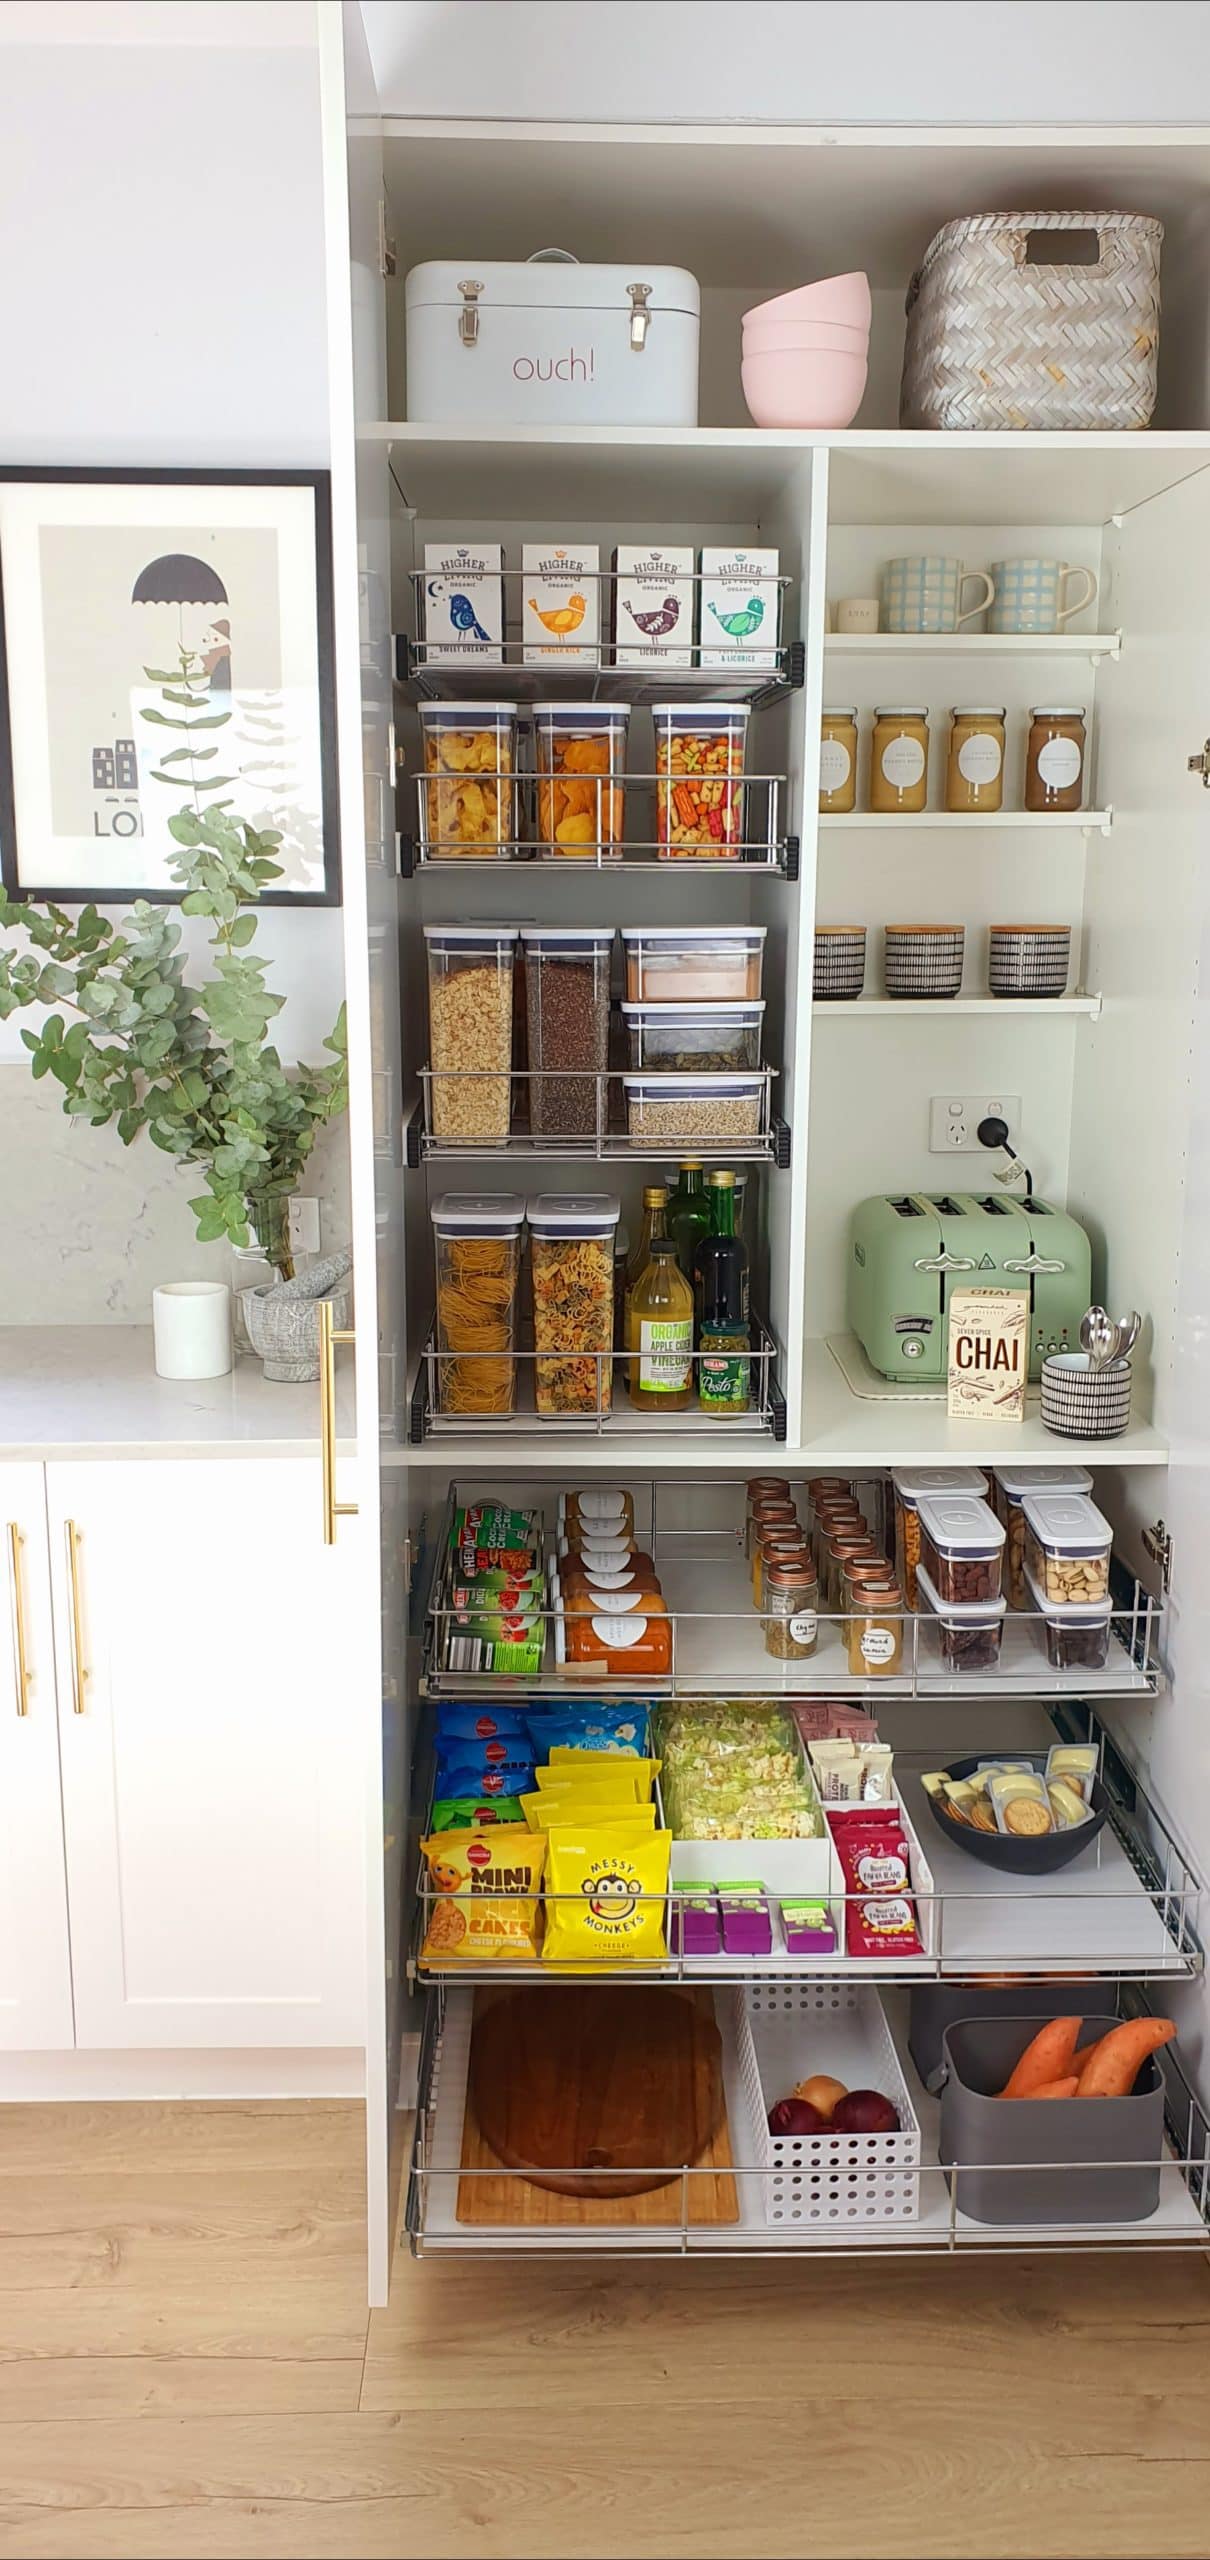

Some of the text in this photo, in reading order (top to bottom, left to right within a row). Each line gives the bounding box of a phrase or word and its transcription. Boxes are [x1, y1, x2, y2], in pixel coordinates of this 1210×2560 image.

[513, 347, 596, 382] ouch!
[440, 559, 486, 571] HIGHER
[538, 560, 584, 572] HIGHER
[633, 562, 678, 574] HIGHER
[718, 564, 762, 576] HIGHER
[970, 1288, 1011, 1297] CHAI
[651, 1341, 673, 1351] APPLE
[956, 1336, 1019, 1371] CHAI
[703, 1376, 734, 1393] Pesto
[590, 1858, 635, 1874] MESSY
[471, 1867, 532, 1887] MINI
[469, 1919, 531, 1936] CAKES
[583, 1914, 645, 1935] MONKEYS
